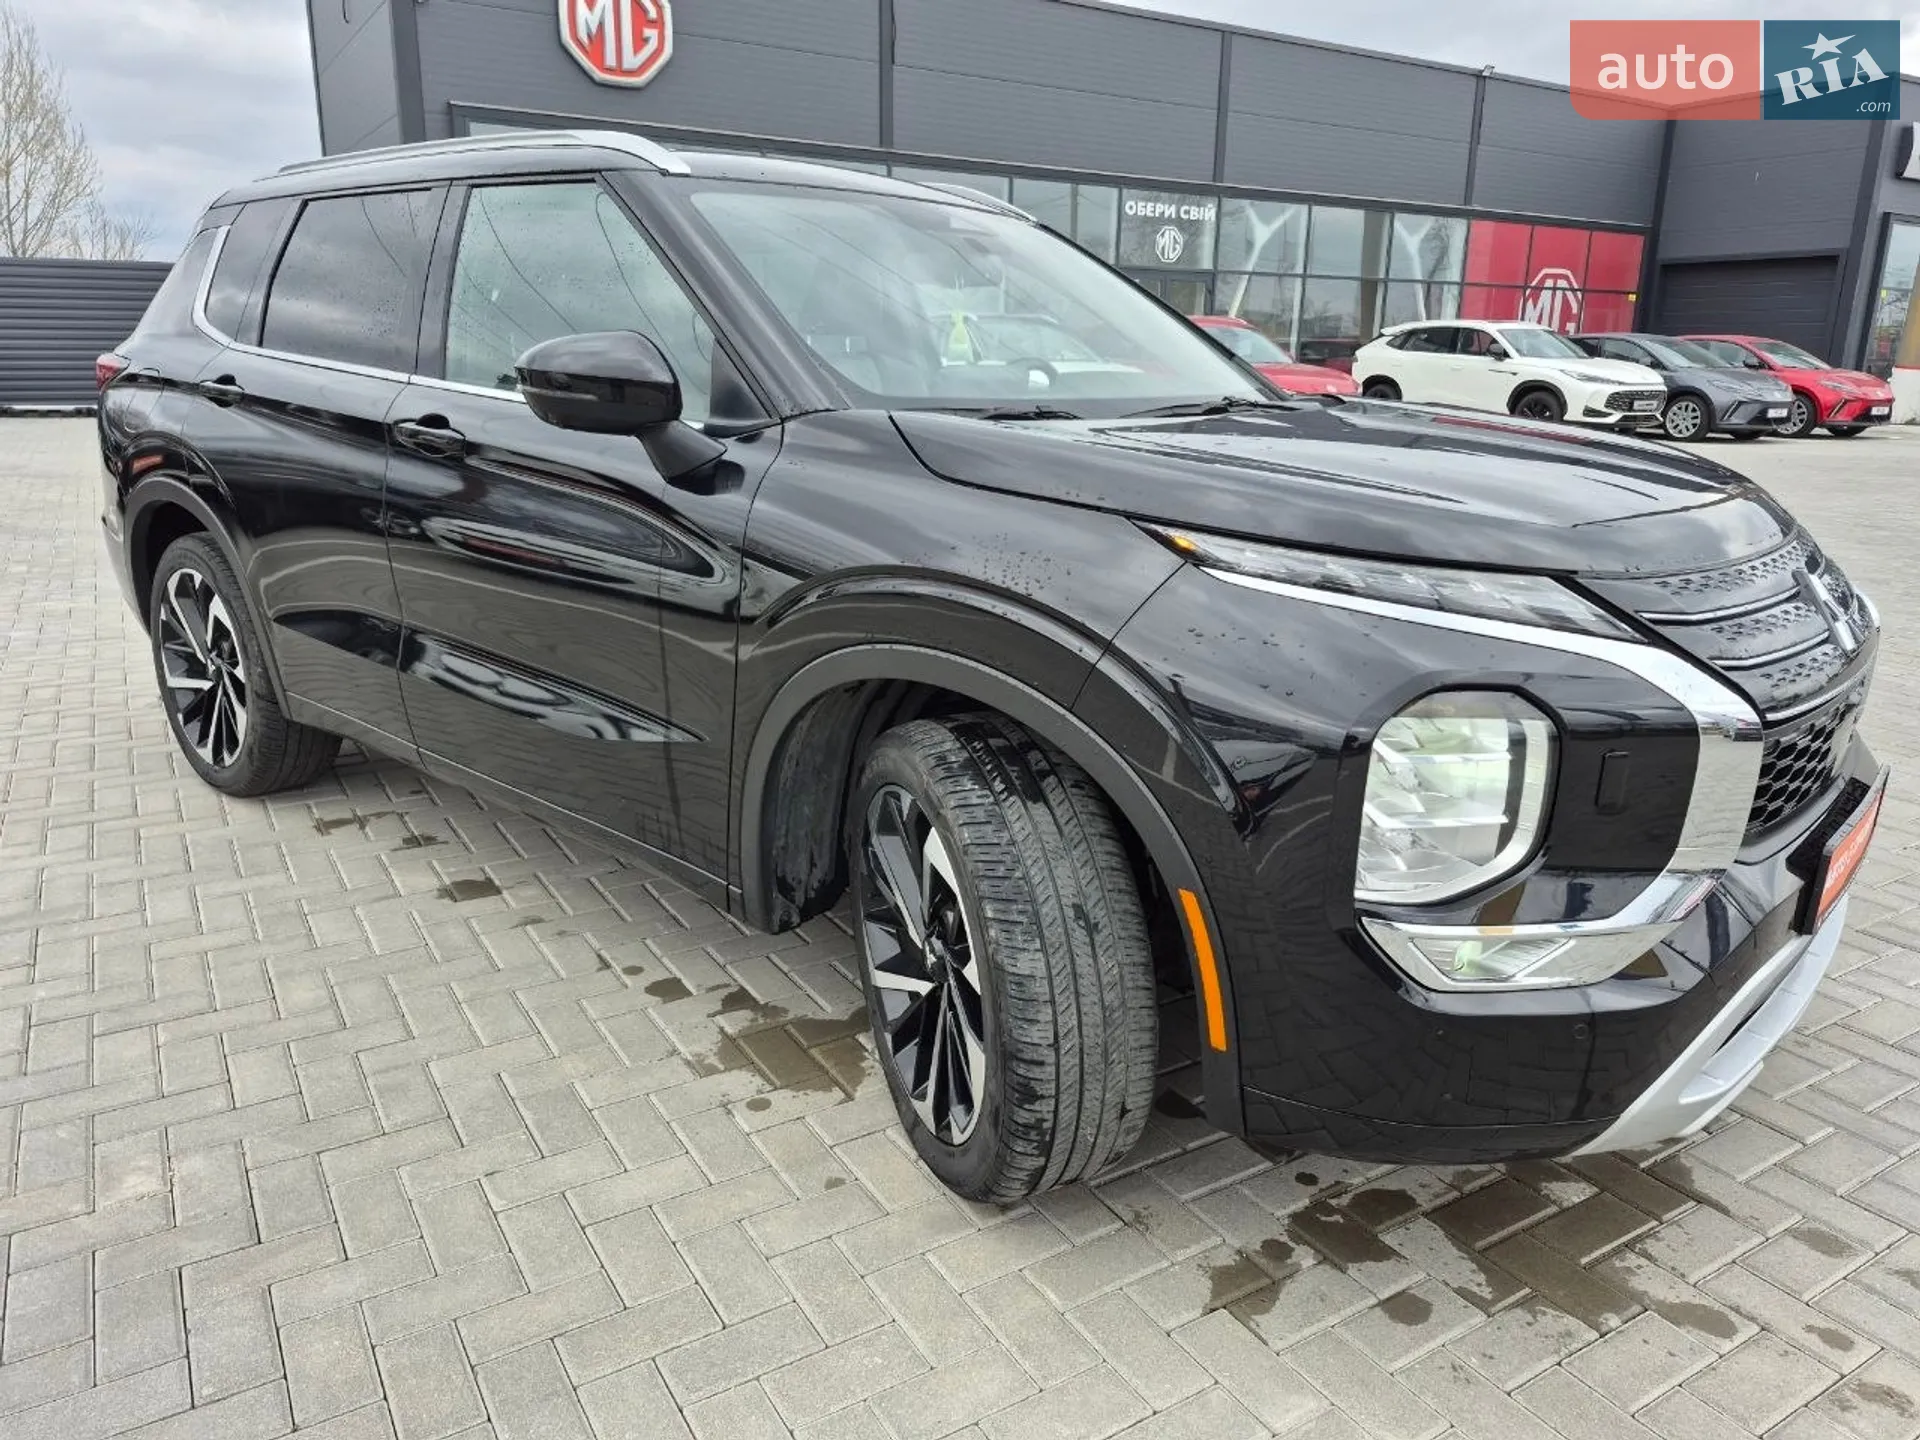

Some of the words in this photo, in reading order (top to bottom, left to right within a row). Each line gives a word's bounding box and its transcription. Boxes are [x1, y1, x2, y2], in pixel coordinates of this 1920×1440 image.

[576, 0, 658, 69] MG
[1125, 201, 1175, 218] ОБЕРИ
[1180, 204, 1216, 220] СВІЙ
[1157, 229, 1182, 260] MG
